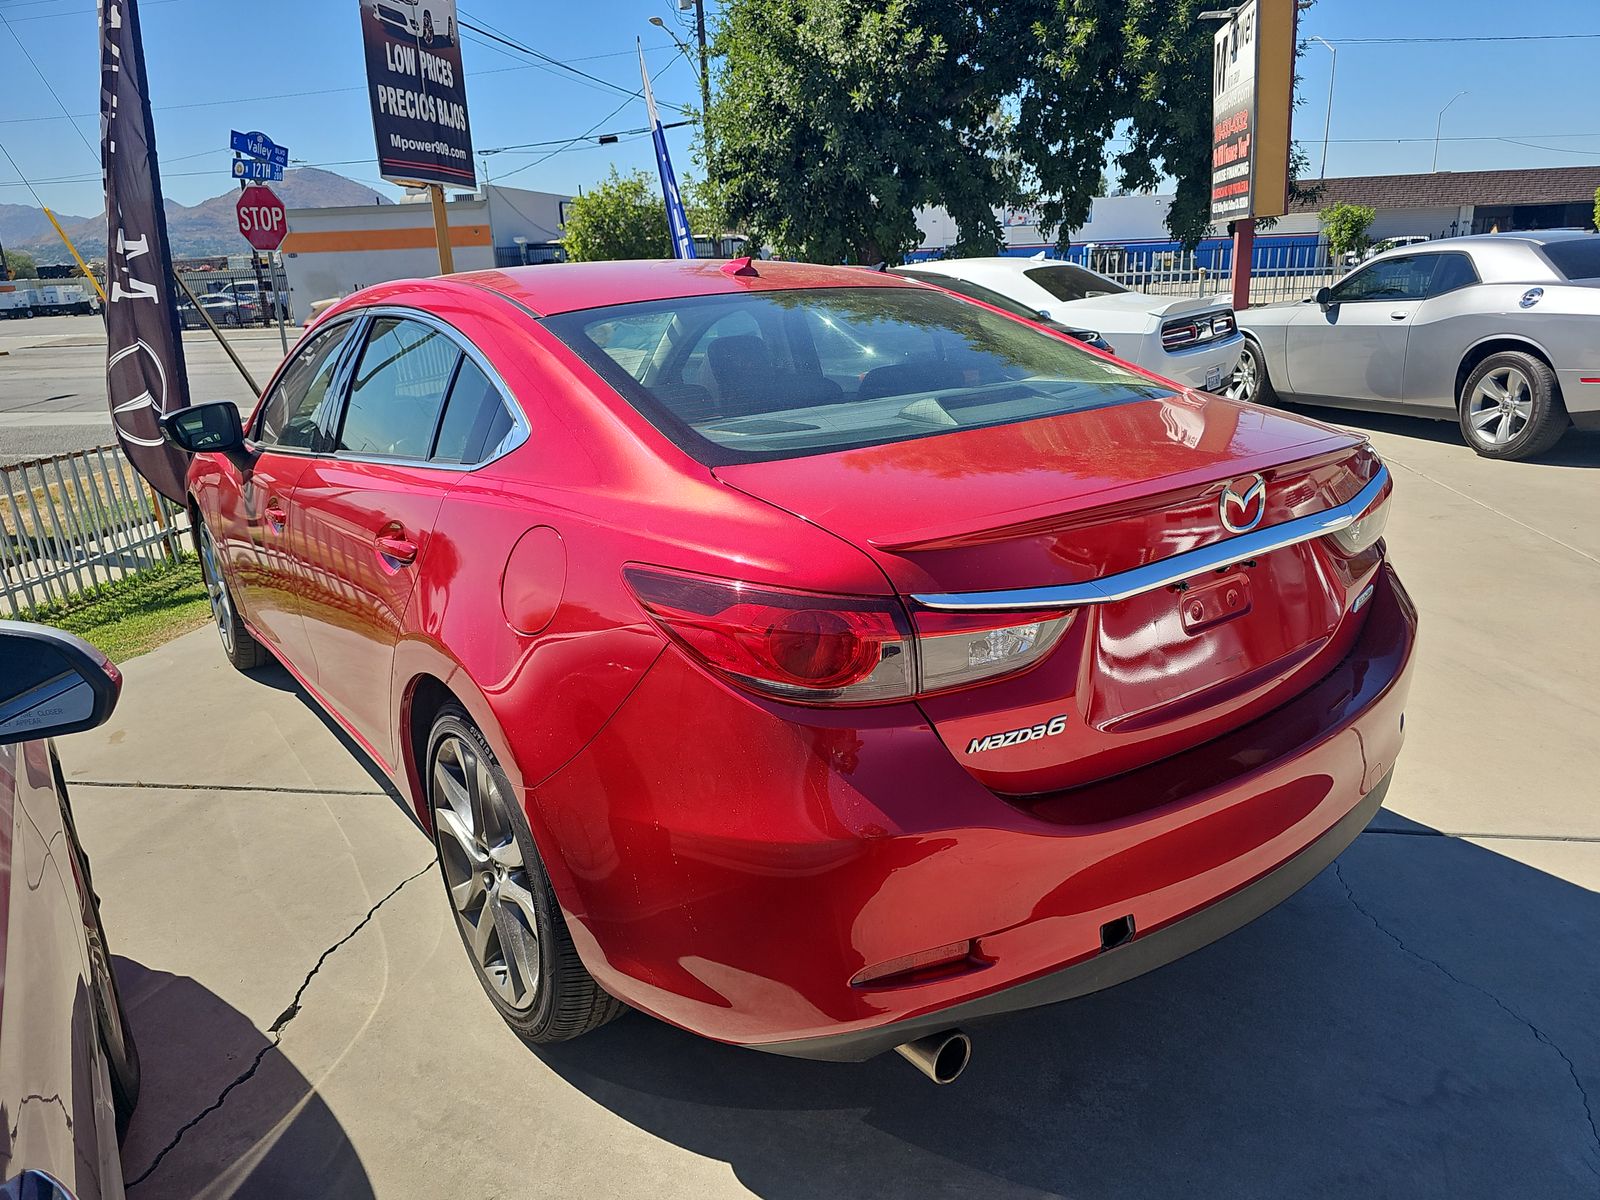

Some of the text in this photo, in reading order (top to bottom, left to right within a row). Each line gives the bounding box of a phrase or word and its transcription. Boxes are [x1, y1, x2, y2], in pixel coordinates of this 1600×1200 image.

[385, 41, 454, 89] LOW PRICES
[377, 84, 466, 132] PRECIOS BAJOS
[233, 136, 238, 145] E
[247, 138, 272, 161] Valley
[390, 133, 467, 160] Mpower909.com
[252, 162, 271, 178] 12TH
[240, 206, 283, 231] STOP
